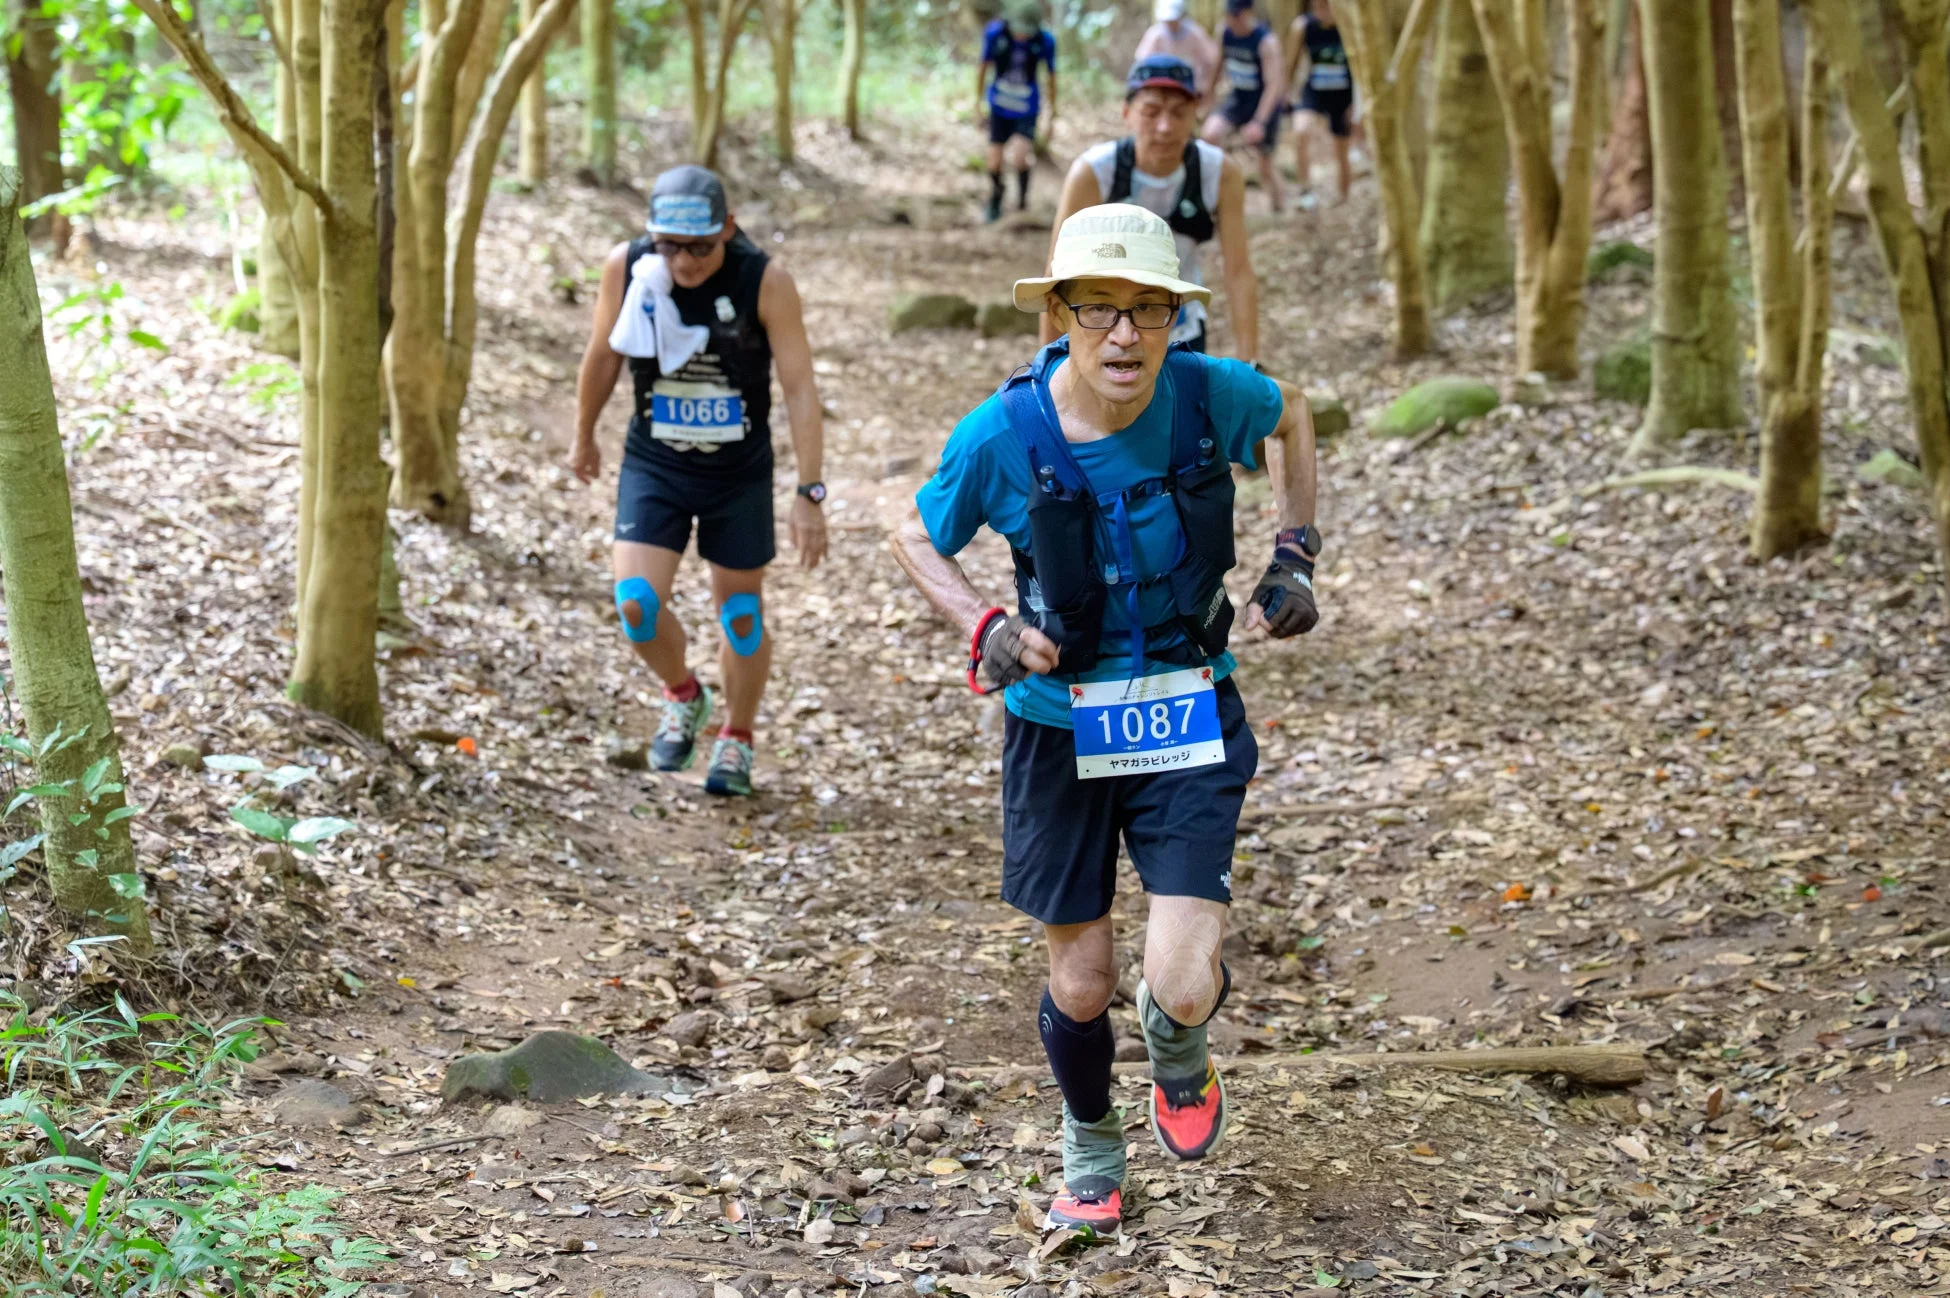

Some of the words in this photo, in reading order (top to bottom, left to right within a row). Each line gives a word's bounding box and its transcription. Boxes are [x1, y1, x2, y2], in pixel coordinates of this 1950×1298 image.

[666, 399, 730, 424] 1066
[1097, 698, 1196, 744] 1087
[1109, 750, 1190, 769] ヤマガラビレッジ
